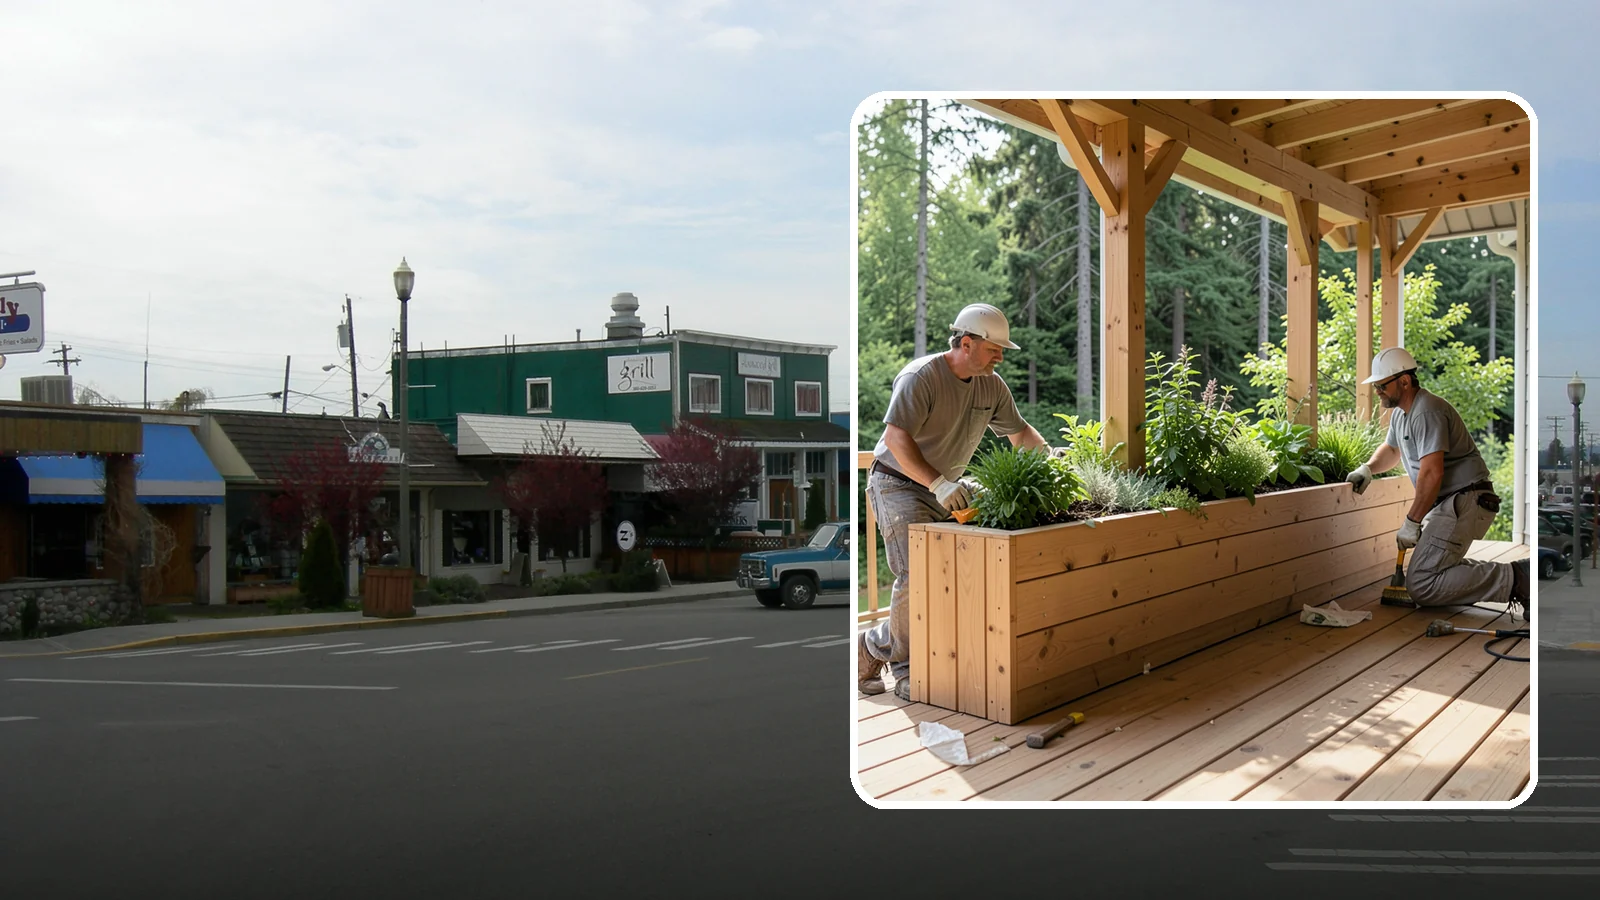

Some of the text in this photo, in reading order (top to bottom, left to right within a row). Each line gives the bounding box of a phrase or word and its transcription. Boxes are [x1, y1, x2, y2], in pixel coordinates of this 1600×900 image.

[3, 338, 16, 346] Fries
[20, 337, 38, 345] Salads
[618, 356, 655, 391] grill
